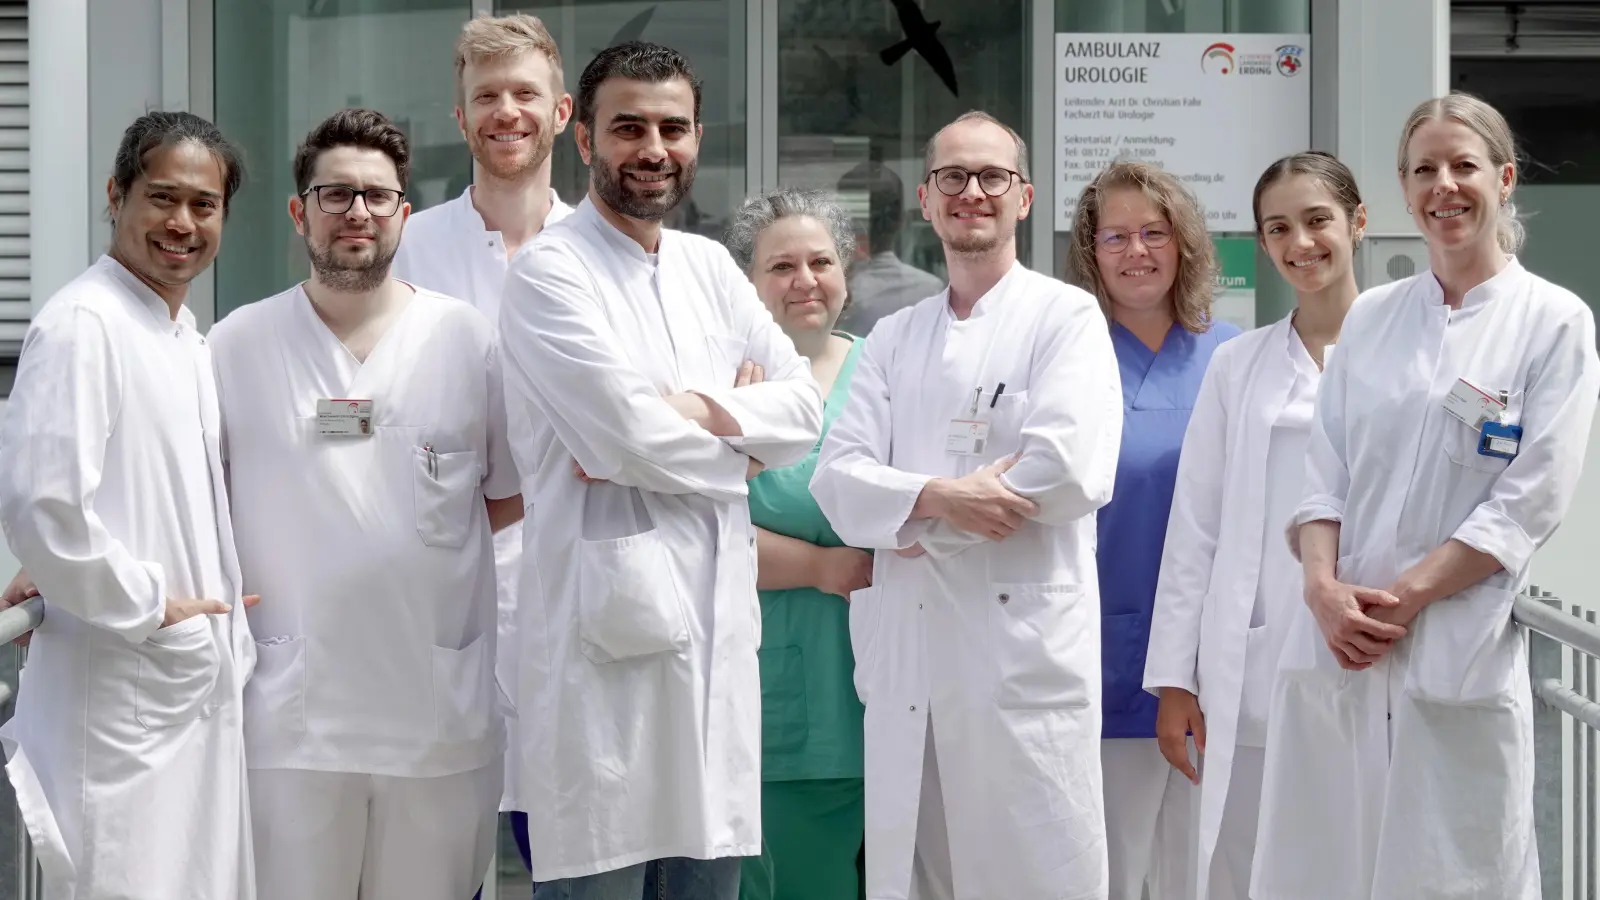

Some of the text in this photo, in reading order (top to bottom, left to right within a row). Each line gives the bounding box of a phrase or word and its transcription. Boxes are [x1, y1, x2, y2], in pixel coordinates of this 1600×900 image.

[1064, 41, 1161, 58] AMBULANZ
[1064, 66, 1149, 84] UROLOGIE
[1239, 67, 1272, 75] ERDING
[1108, 98, 1126, 107] Arzt
[1142, 97, 1181, 107] Christian
[1064, 109, 1100, 120] Facharzt
[1117, 109, 1156, 121] Urologie
[1064, 134, 1112, 145] Sekretariat
[1081, 147, 1110, 157] 08122
[1221, 210, 1238, 220] Uhr
